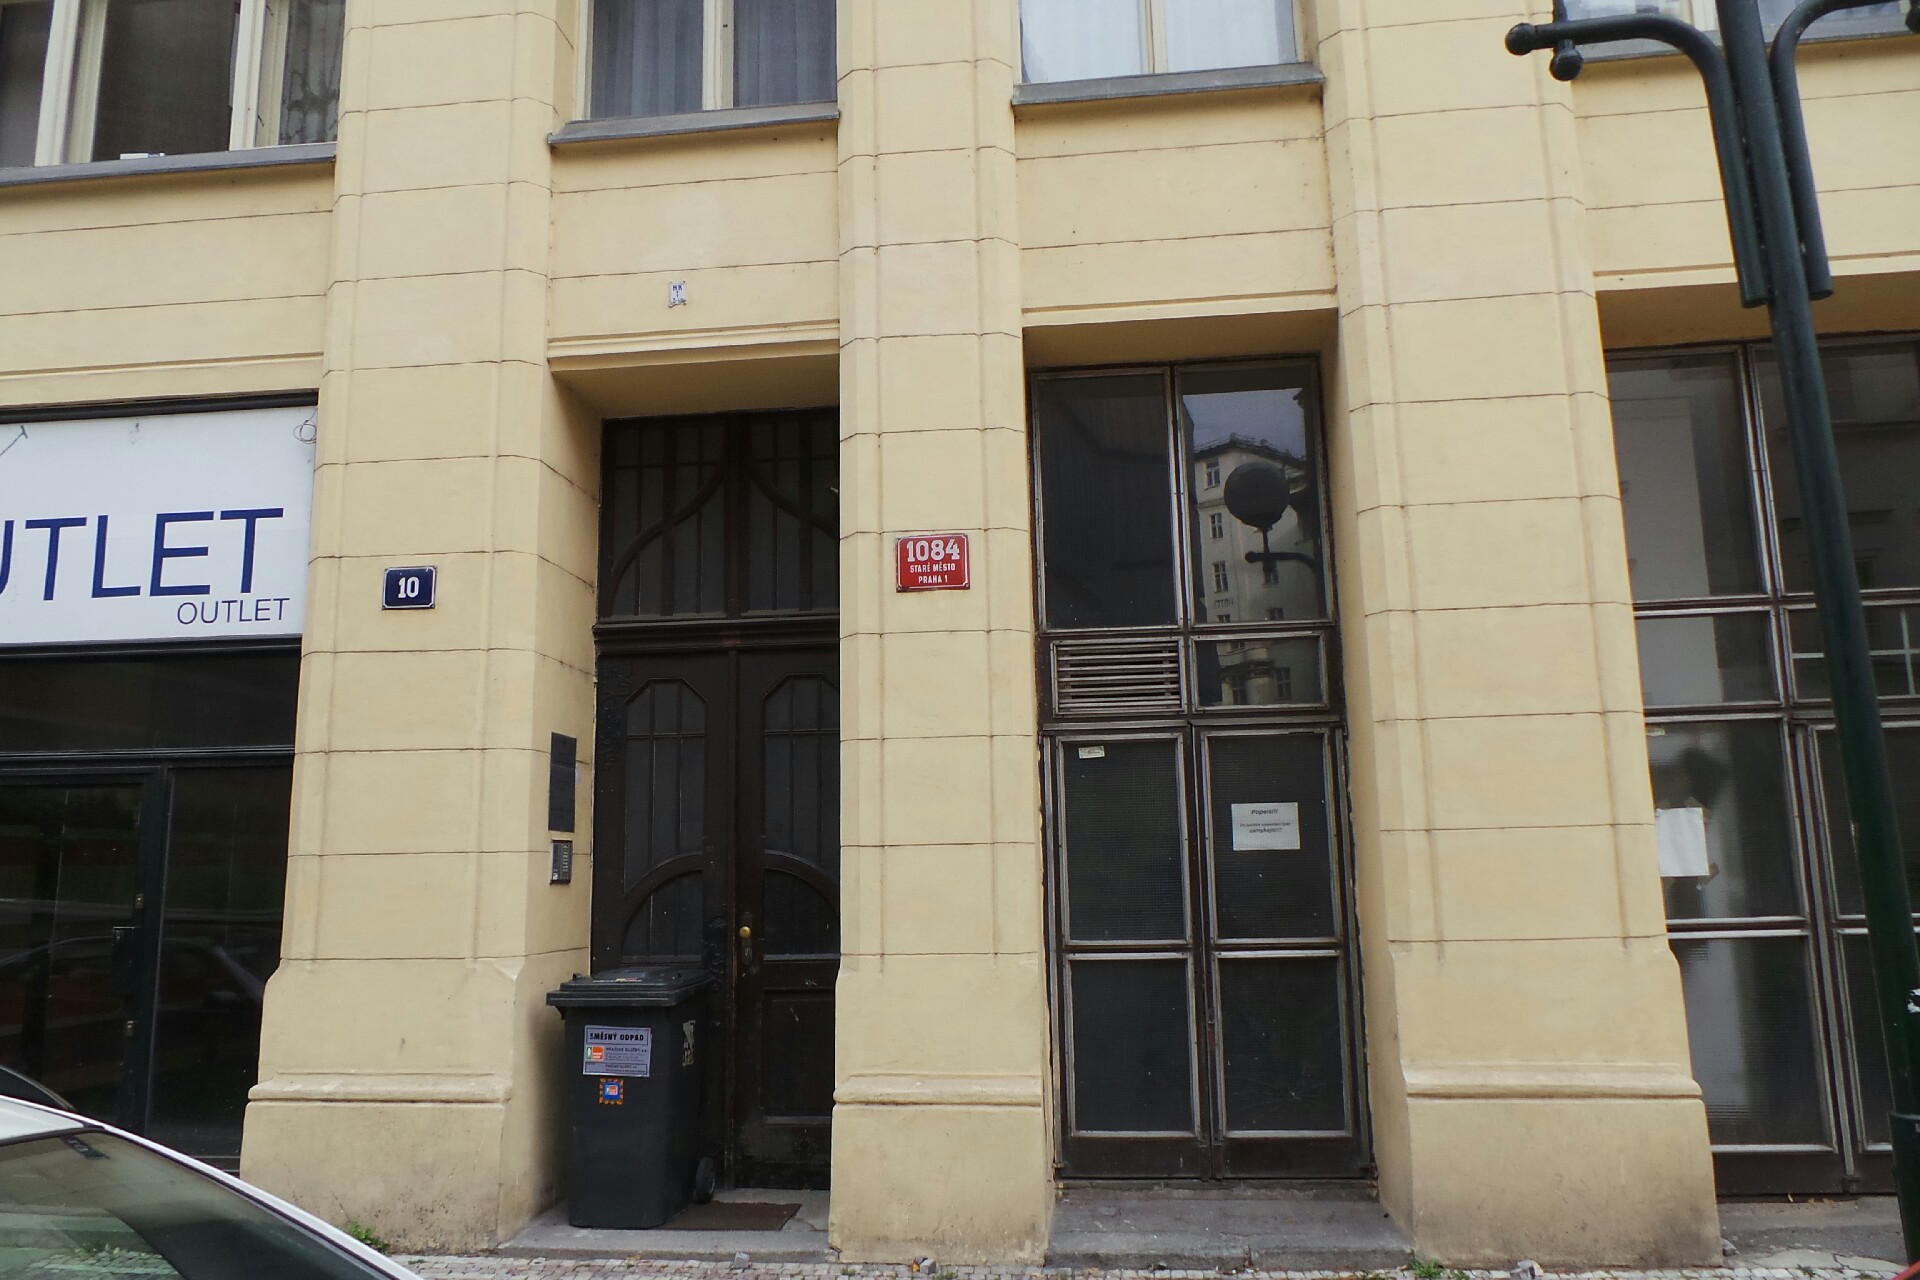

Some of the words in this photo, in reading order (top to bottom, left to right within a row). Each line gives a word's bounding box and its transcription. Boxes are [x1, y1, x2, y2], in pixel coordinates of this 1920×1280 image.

[0, 507, 284, 601] TLET
[906, 538, 960, 562] 1084
[909, 562, 931, 573] STARÉ
[932, 561, 956, 572] MĚSTO
[397, 576, 420, 599] 10
[918, 575, 943, 584] PRAHA
[944, 574, 948, 583] 1
[177, 597, 291, 625] OUTLET
[589, 1031, 618, 1040] SMĚSNÝ
[619, 1033, 644, 1041] ODPAD
